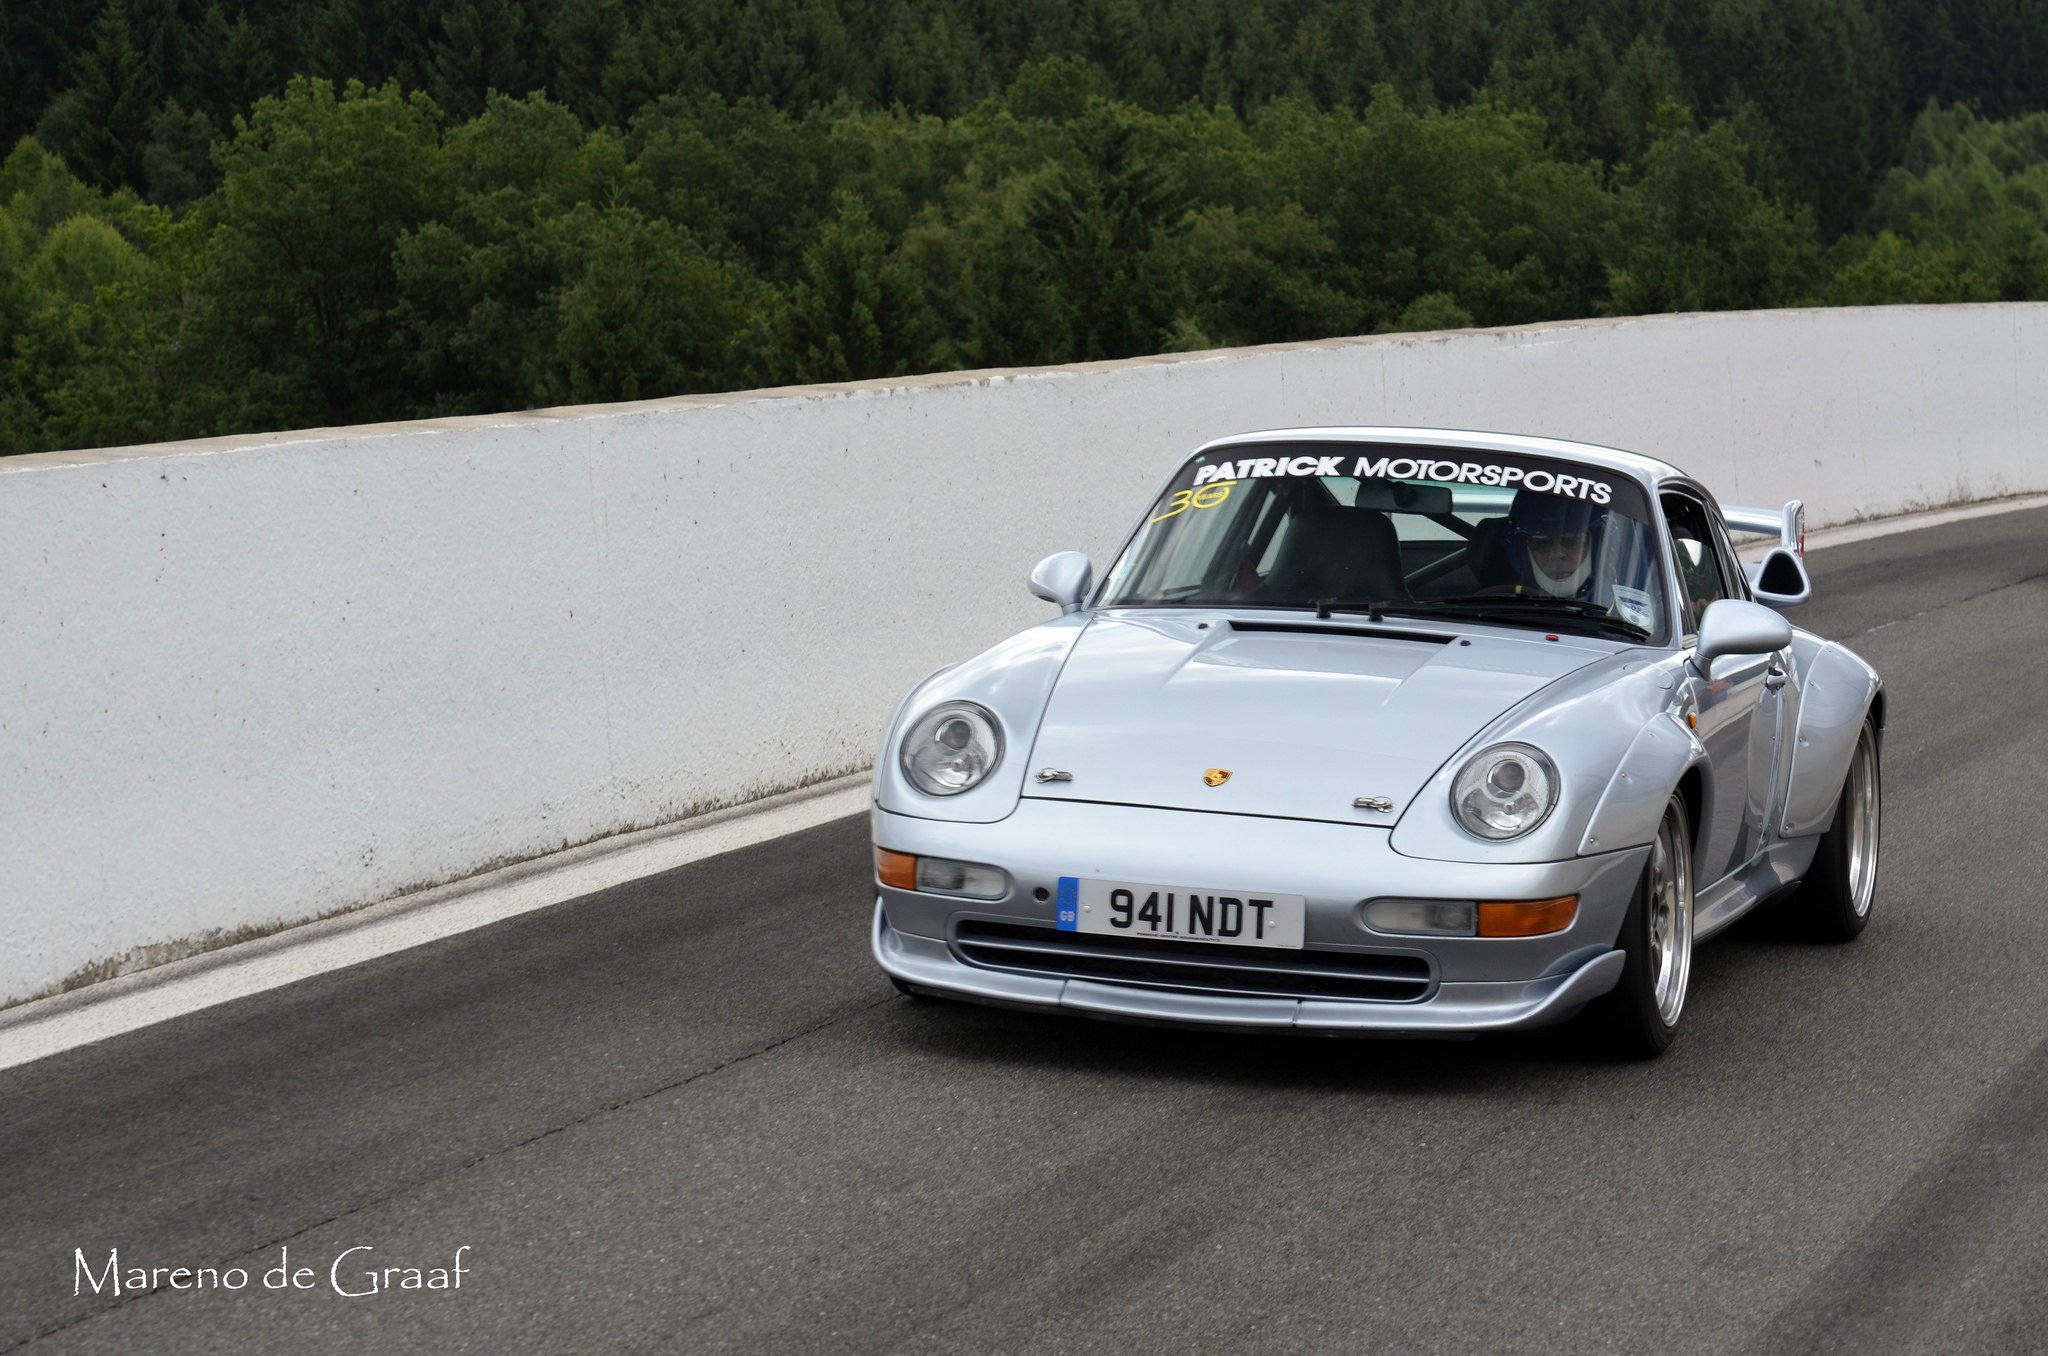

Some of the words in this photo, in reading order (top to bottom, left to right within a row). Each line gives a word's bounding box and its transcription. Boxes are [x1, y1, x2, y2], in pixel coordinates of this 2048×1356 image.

[1152, 480, 1238, 523] 30
[1192, 456, 1346, 486] PATRICK
[1353, 456, 1613, 504] MOTORSPORTS
[1060, 910, 1075, 921] GB
[1110, 889, 1174, 933] 941
[1189, 894, 1274, 939] NDT
